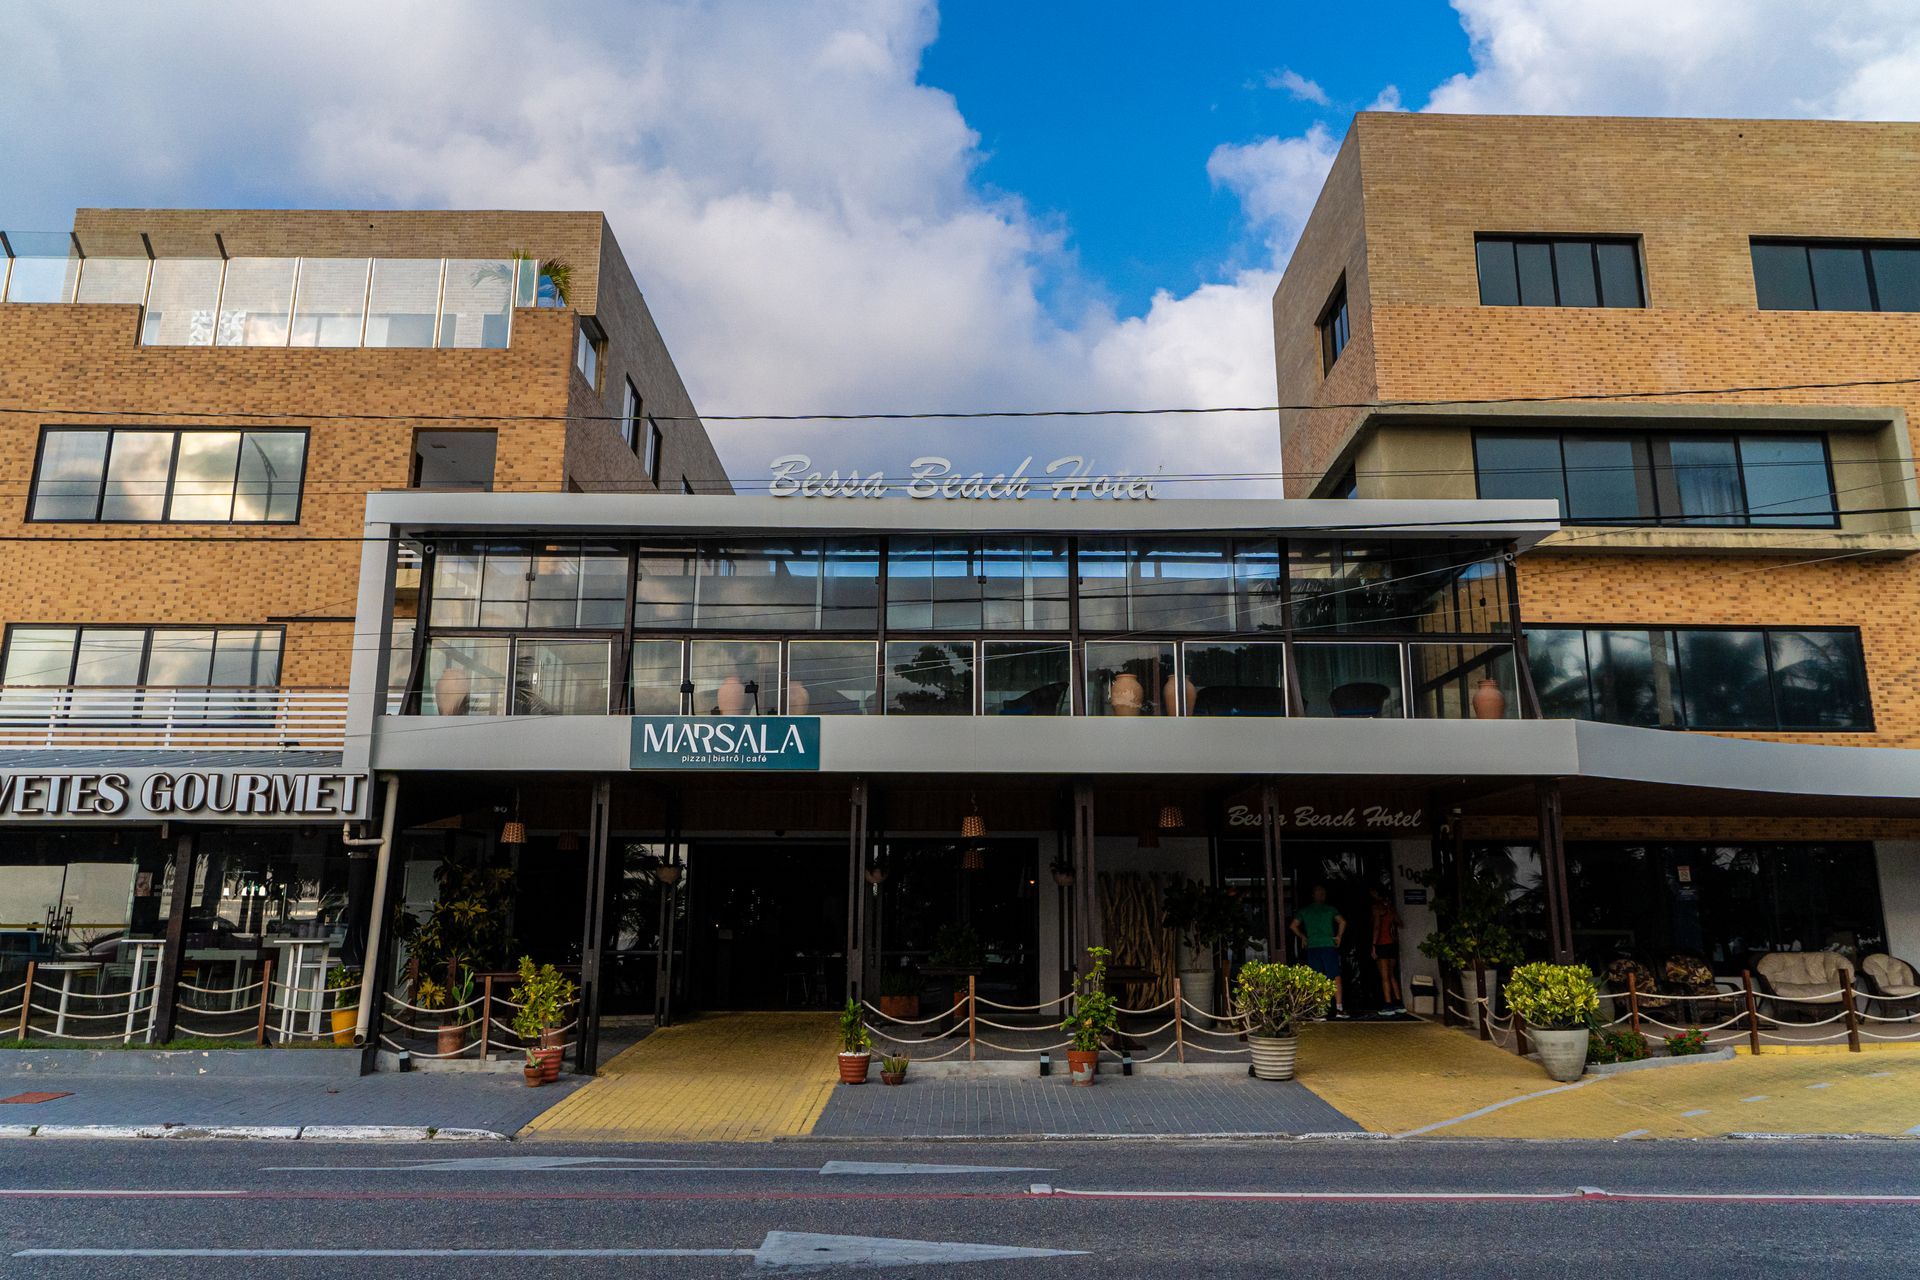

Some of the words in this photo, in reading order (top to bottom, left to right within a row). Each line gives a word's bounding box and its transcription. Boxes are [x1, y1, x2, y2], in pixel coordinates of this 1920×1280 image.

[768, 453, 889, 499] Bessa
[906, 455, 1035, 500] Beach
[643, 723, 805, 754] MARSALA
[681, 755, 706, 763] pizza
[746, 754, 767, 763] café
[141, 773, 368, 815] GOURMET
[1294, 805, 1357, 827] Beach
[1362, 805, 1422, 827] Hotel
